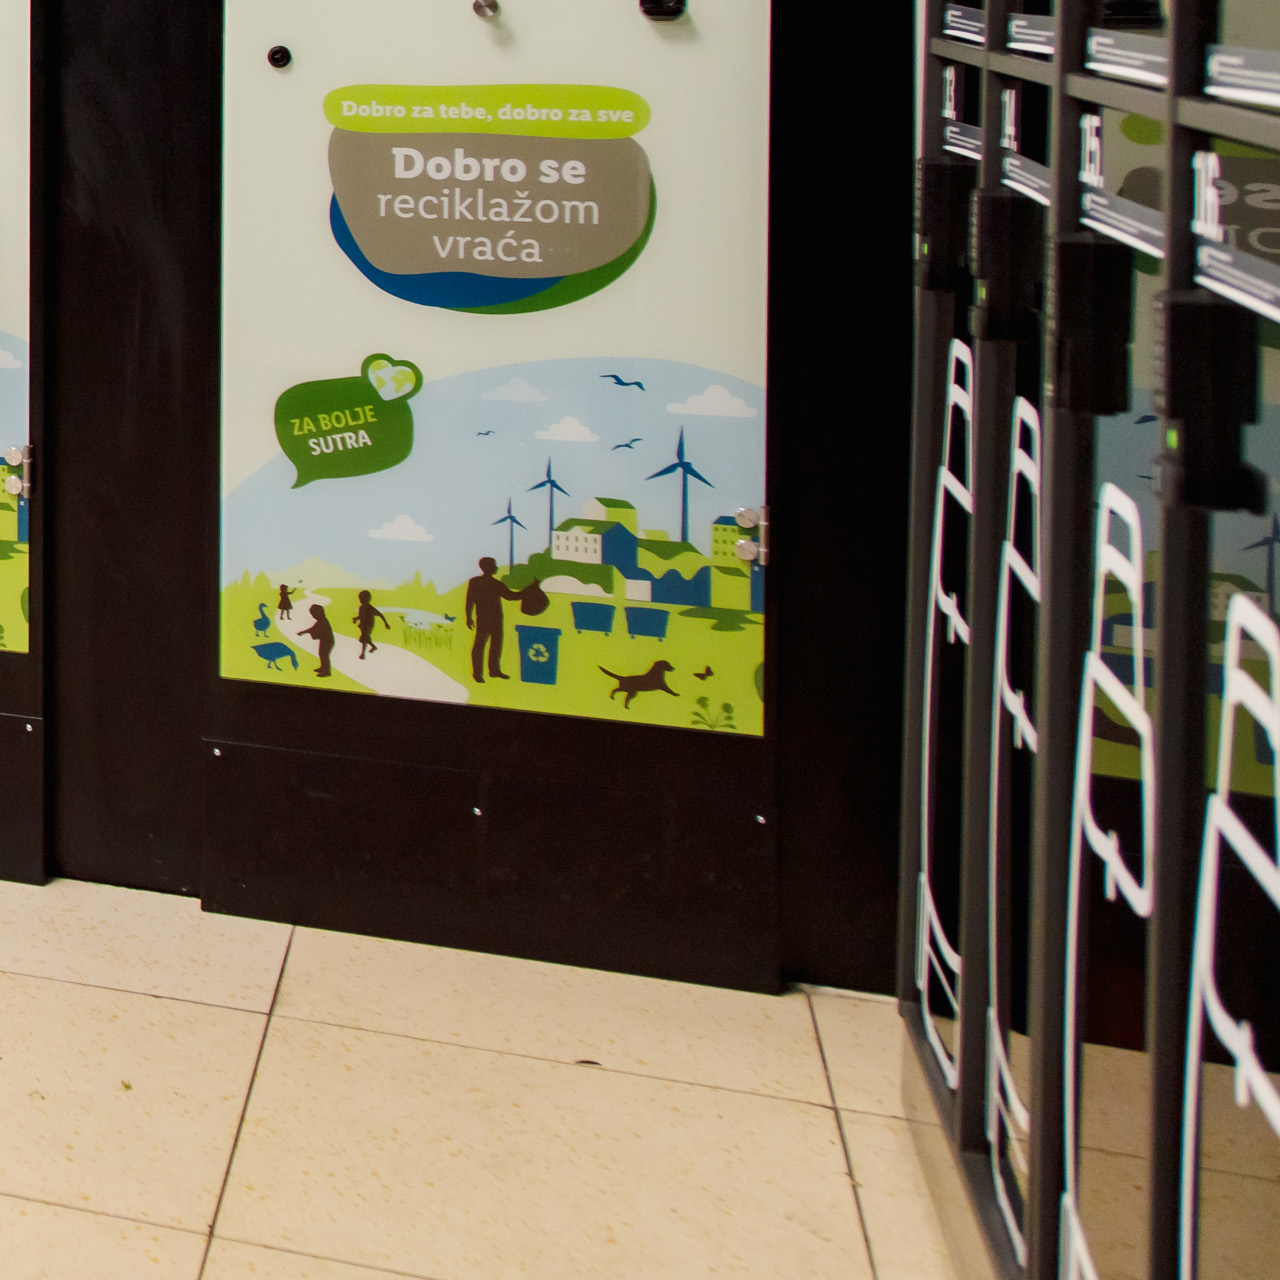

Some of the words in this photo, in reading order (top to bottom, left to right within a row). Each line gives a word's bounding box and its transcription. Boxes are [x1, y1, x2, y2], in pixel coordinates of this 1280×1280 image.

[341, 100, 406, 118] Dobro
[411, 105, 435, 118] za
[438, 102, 493, 122] tebe,
[497, 103, 563, 121] dobro
[568, 109, 593, 122] za
[597, 109, 634, 123] sve
[392, 147, 527, 183] Dobro
[539, 159, 586, 185] se
[377, 187, 599, 225] reciklažom
[432, 232, 543, 263] vraća
[291, 417, 316, 436] ZA
[319, 405, 377, 432] BOLJE
[309, 430, 372, 456] SUTRA
